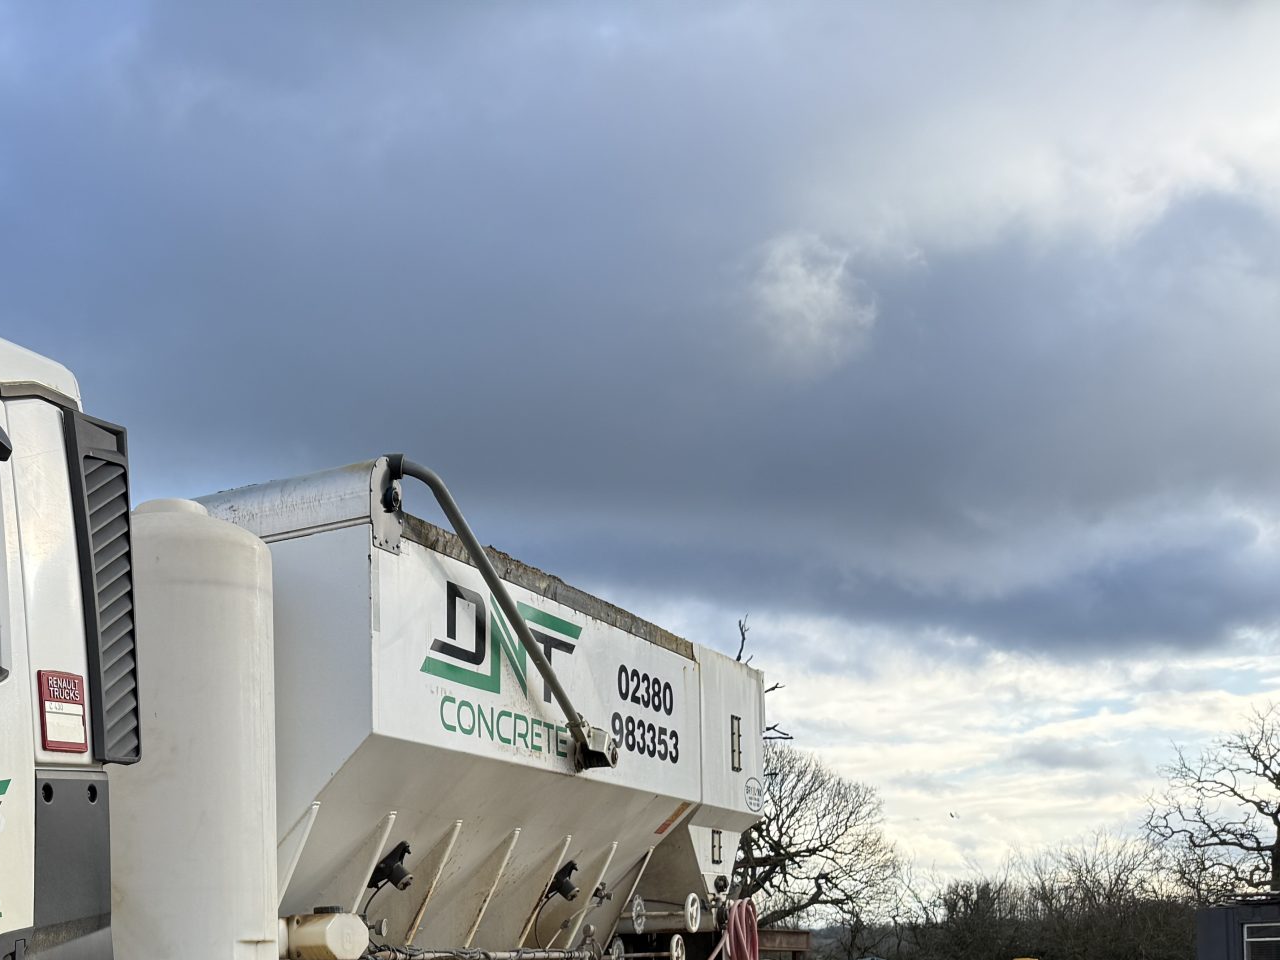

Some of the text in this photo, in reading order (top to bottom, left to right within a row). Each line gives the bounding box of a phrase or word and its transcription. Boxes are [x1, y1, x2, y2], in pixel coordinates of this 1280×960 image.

[420, 580, 583, 703] DNT
[48, 676, 79, 690] RENAULT
[49, 687, 80, 700] TRUCKS
[617, 664, 673, 716] 02380
[440, 695, 567, 758] CONCRETE
[611, 711, 679, 764] 983353
